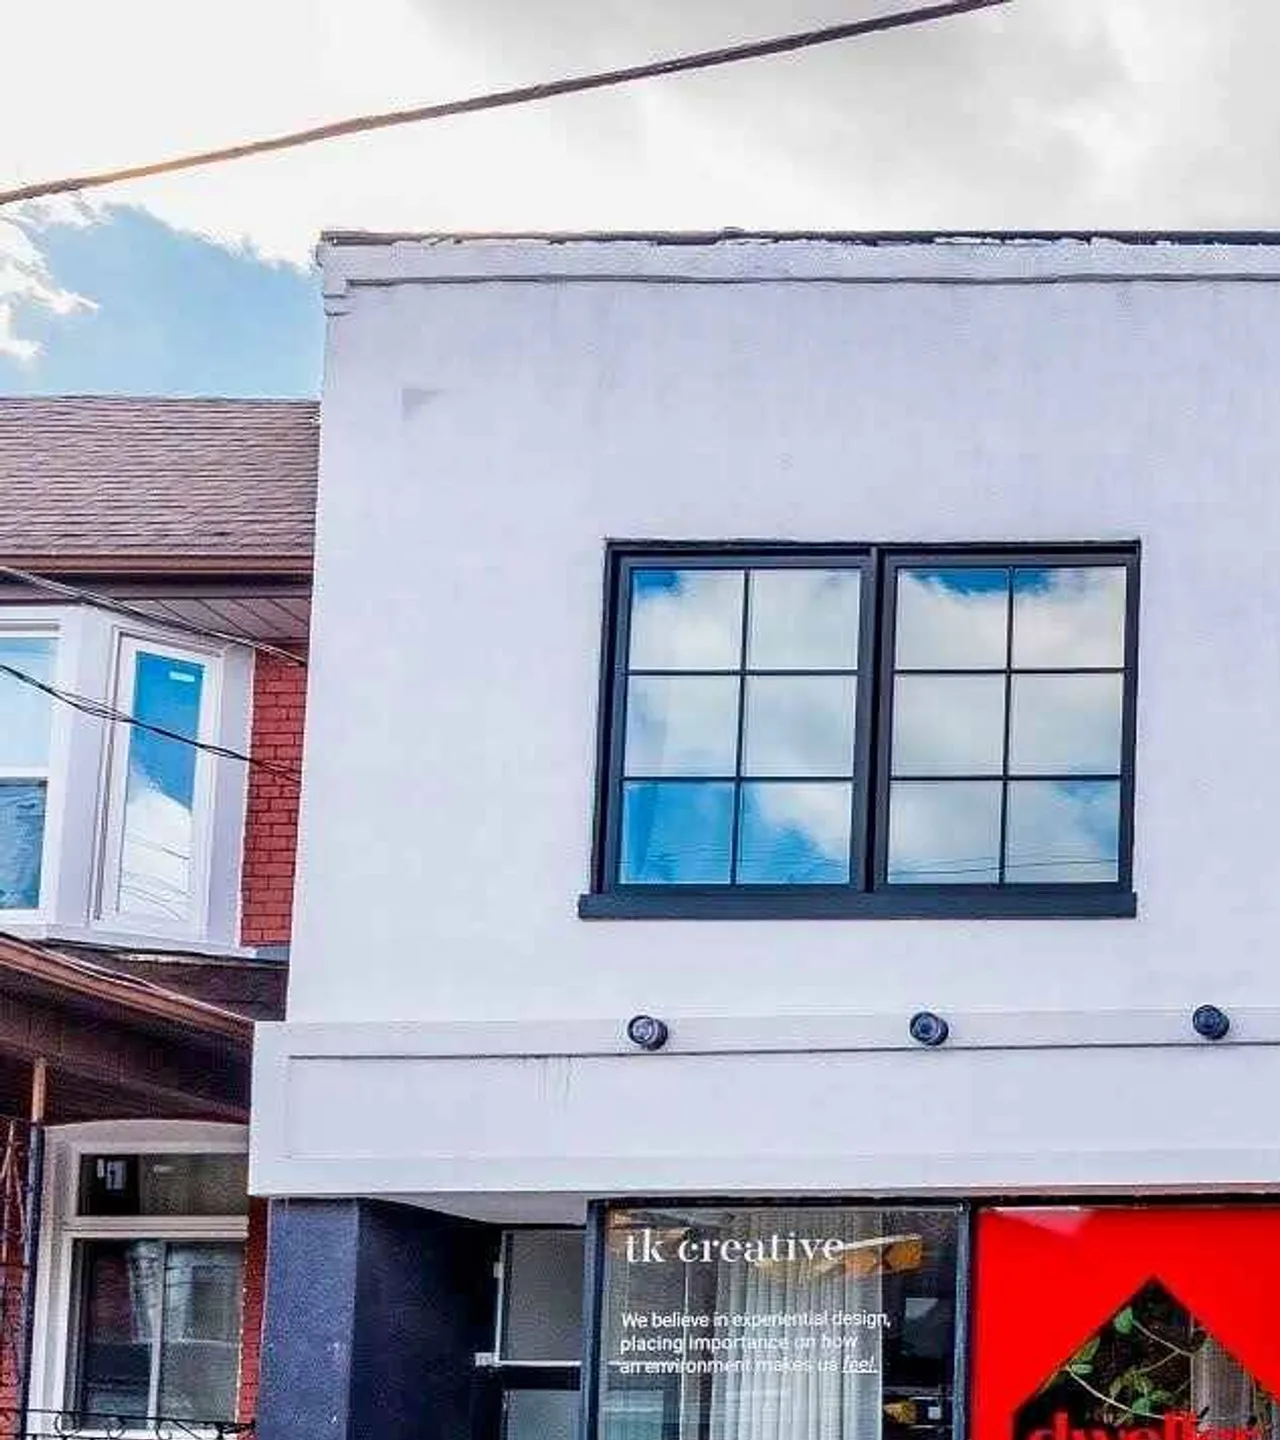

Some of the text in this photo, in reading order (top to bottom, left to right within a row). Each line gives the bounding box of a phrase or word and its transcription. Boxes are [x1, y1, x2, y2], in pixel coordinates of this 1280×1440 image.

[627, 1228, 845, 1263] tk creative
[622, 1312, 648, 1328] We
[652, 1312, 709, 1328] believe
[713, 1312, 728, 1327] in
[832, 1310, 891, 1329] design,
[620, 1336, 682, 1354] placing
[794, 1338, 815, 1350] on
[821, 1334, 858, 1349] how
[620, 1361, 640, 1374] an
[817, 1360, 838, 1372] us
